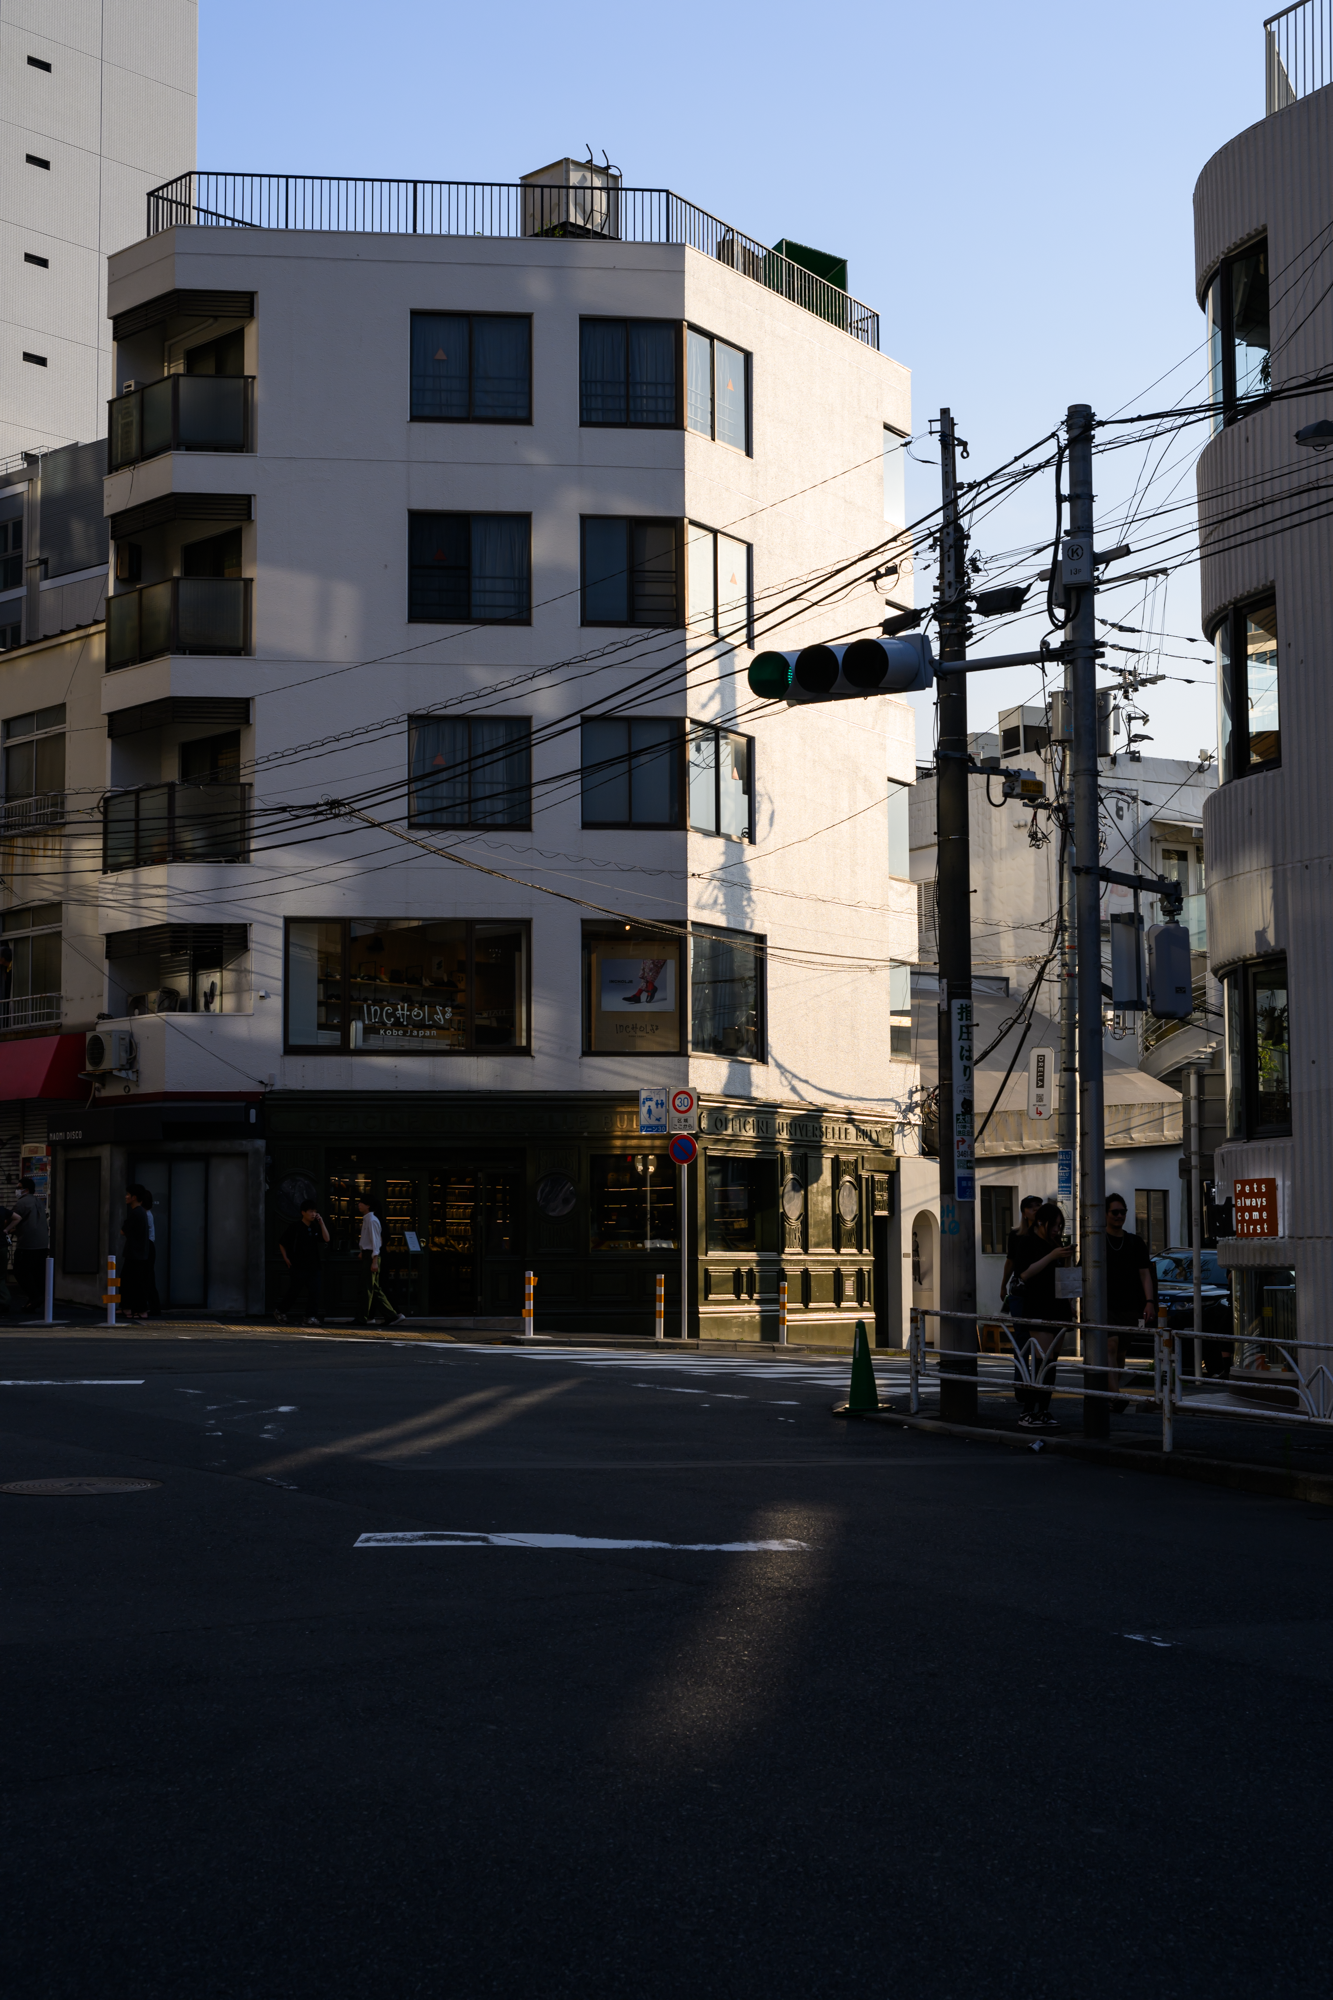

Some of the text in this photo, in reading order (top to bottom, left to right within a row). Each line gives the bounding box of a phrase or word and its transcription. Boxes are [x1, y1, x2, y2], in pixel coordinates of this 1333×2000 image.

[379, 1028, 437, 1038] Kobe Japan
[677, 1096, 689, 1108] 30
[306, 1115, 420, 1131] OFFICINE
[433, 1114, 589, 1131] UNIVERSELLE
[714, 1116, 882, 1143] OFFICINE UNIVERSELLE BULY
[49, 1131, 82, 1140] NAOMI DISCO
[1236, 1182, 1266, 1193] Pets
[1237, 1197, 1266, 1208] always
[1237, 1211, 1267, 1220] come
[1237, 1222, 1268, 1234] first
